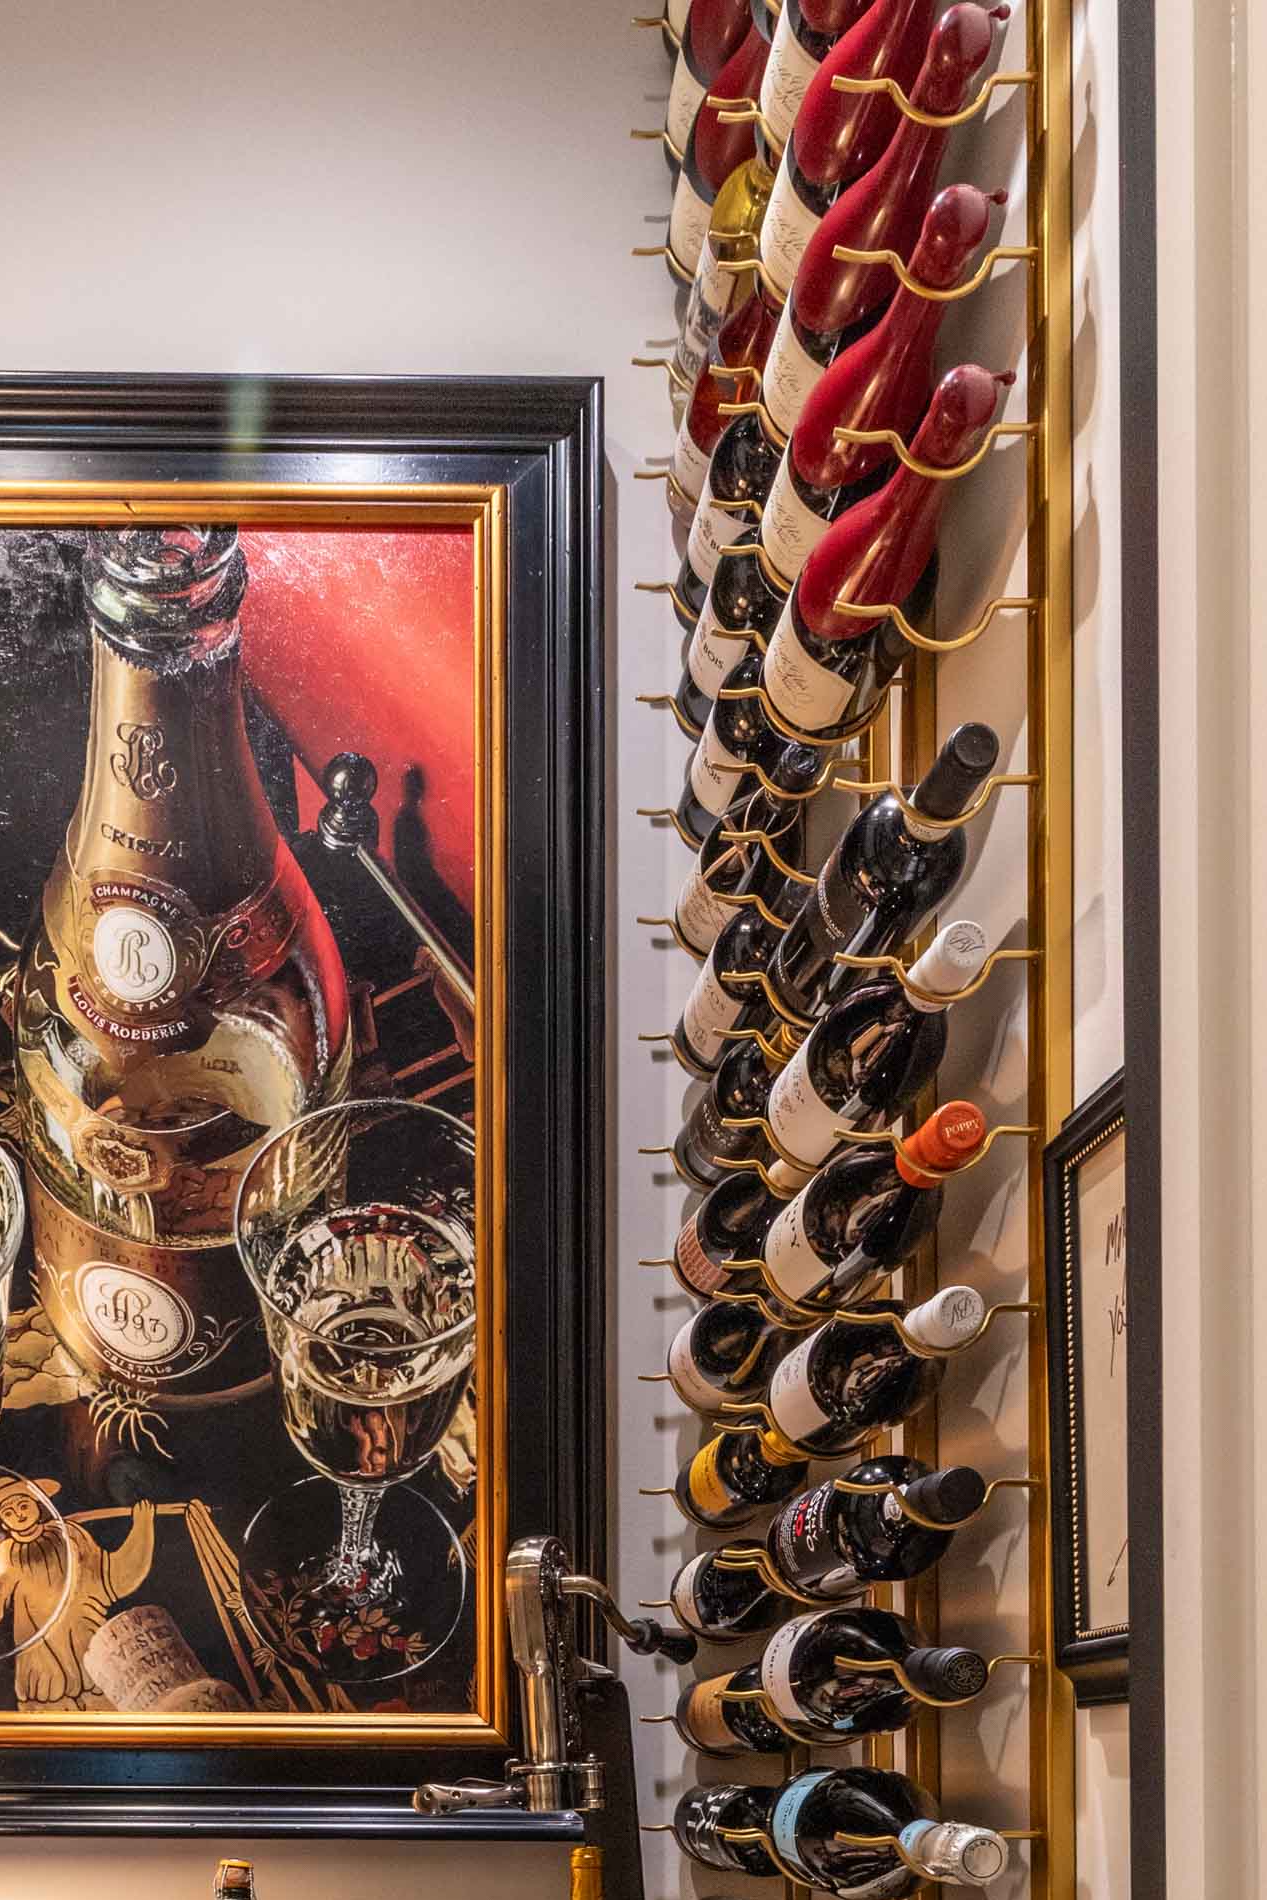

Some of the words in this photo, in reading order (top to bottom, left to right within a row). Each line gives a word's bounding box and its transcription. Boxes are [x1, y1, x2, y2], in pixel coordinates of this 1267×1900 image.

[95, 885, 181, 920] CHAMPAGNE
[72, 990, 107, 1029] LOUIS
[109, 1020, 190, 1041] ROEDERER
[945, 1118, 980, 1139] POPPY
